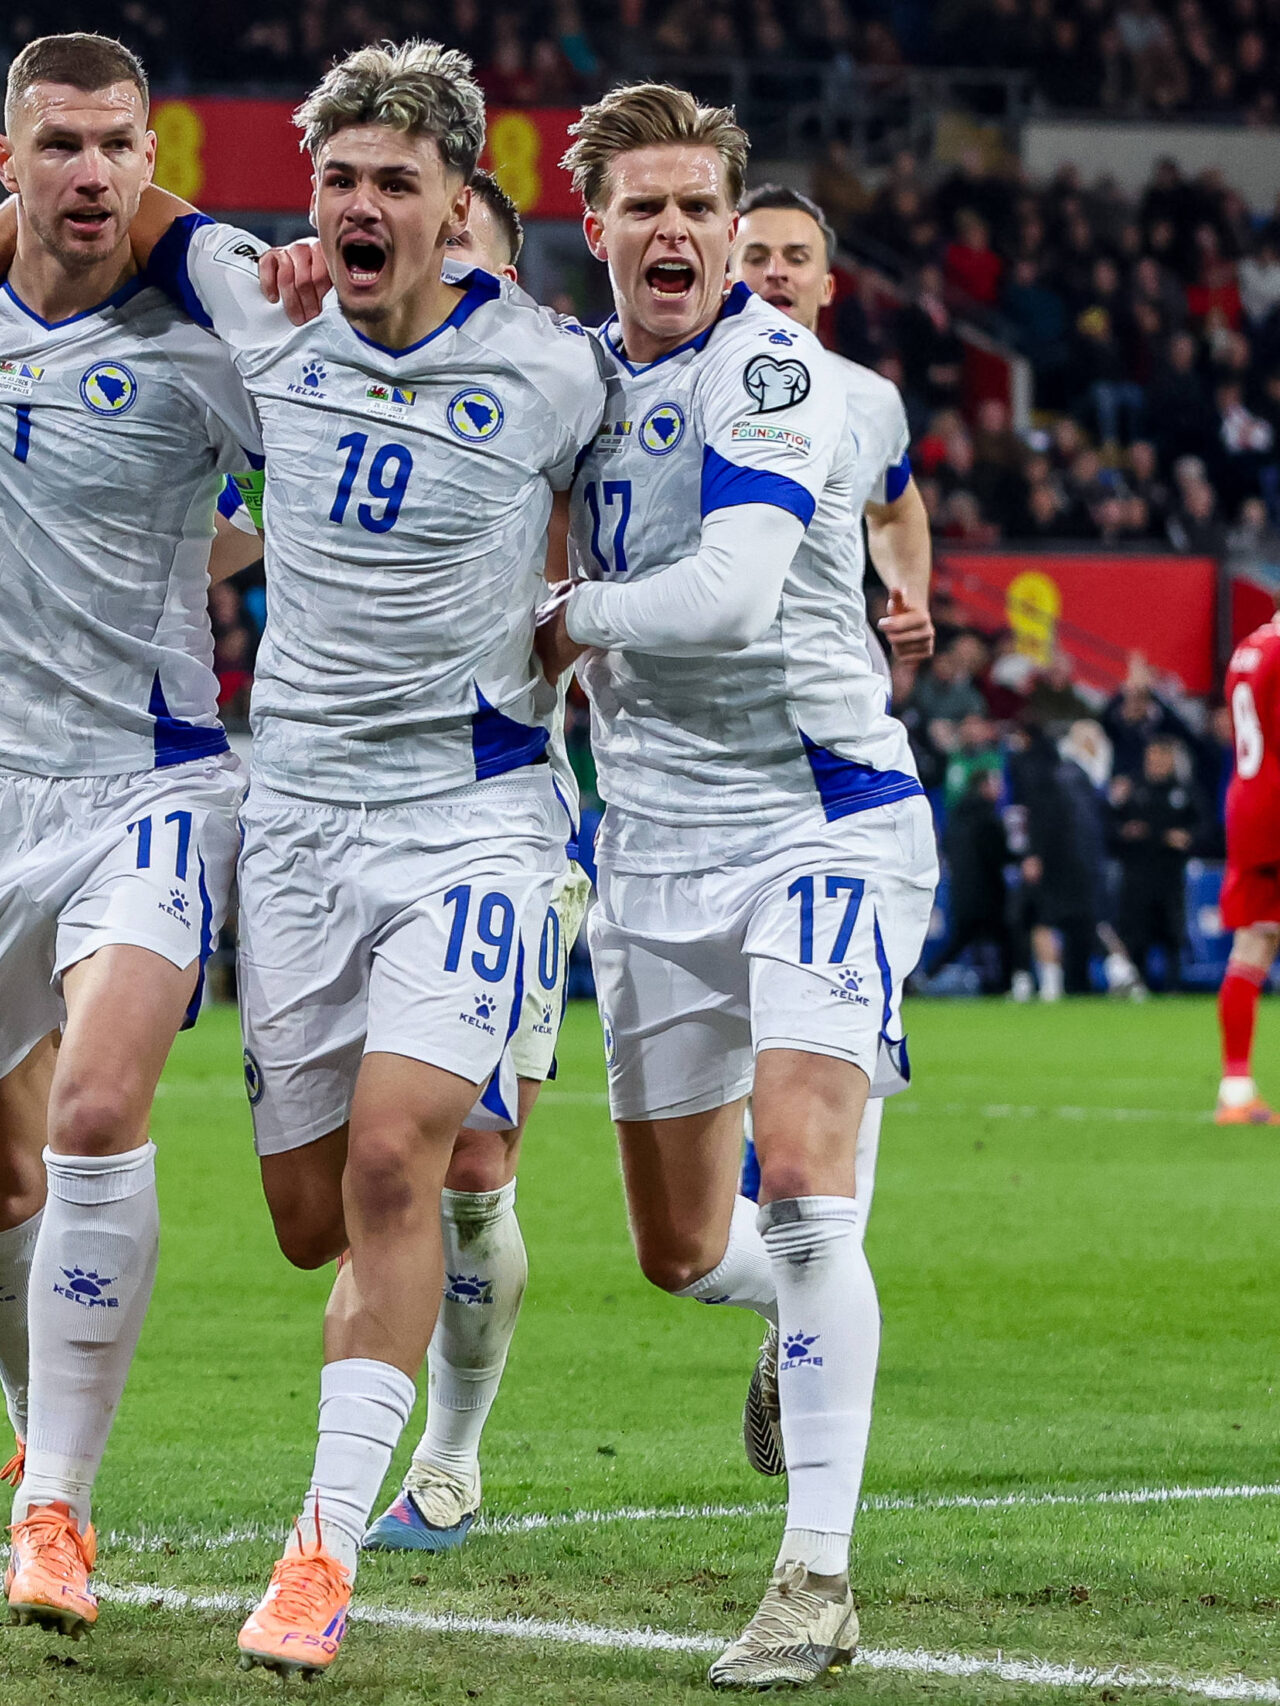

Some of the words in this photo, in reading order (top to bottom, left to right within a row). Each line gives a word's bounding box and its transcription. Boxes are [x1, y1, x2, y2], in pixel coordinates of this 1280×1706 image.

[287, 383, 327, 399] KELME
[731, 428, 811, 450] FOUNDATION
[329, 432, 413, 534] 19
[584, 480, 632, 573] 17
[126, 810, 192, 882] 11
[158, 902, 191, 930] KELME
[787, 875, 865, 964] 17
[443, 884, 515, 983] 19
[830, 988, 870, 1006] KELME
[459, 1012, 497, 1036] KELME
[53, 1283, 120, 1308] KELME
